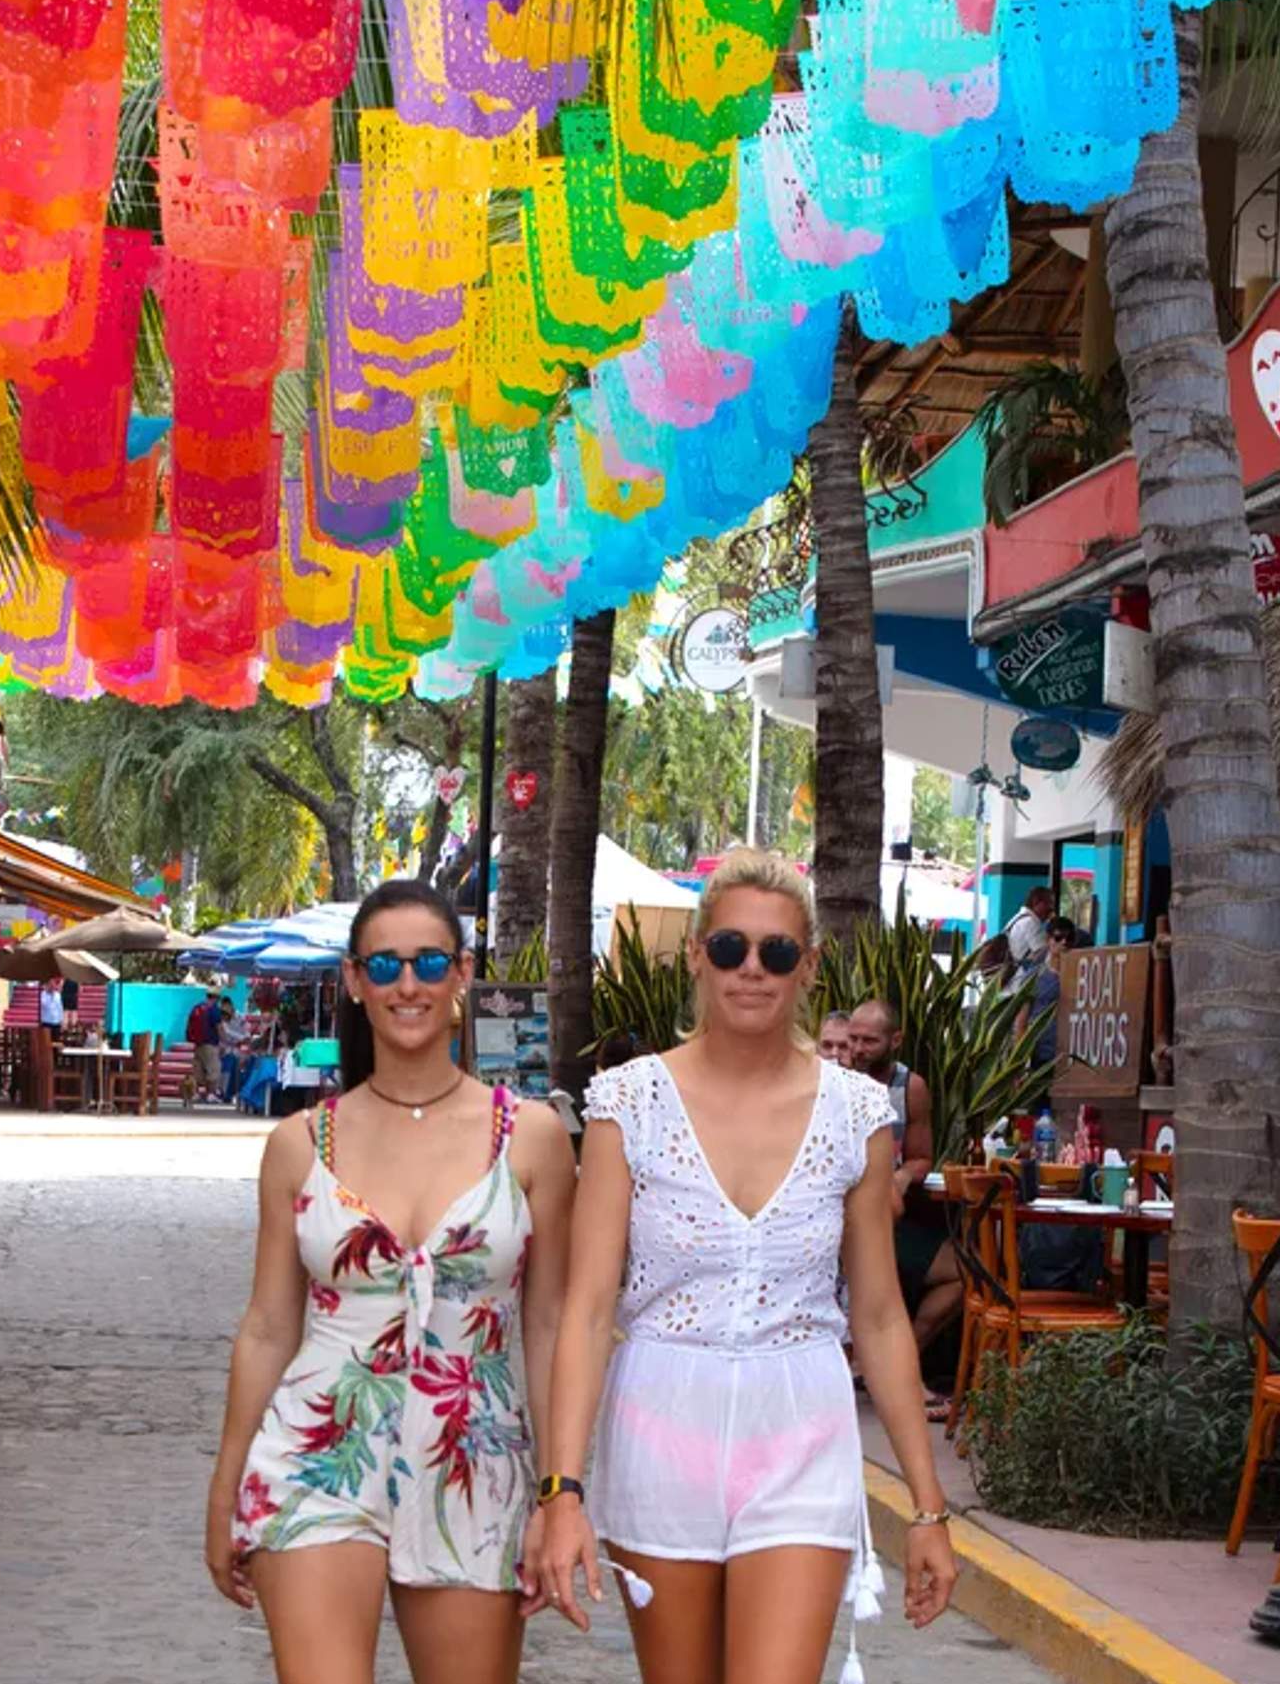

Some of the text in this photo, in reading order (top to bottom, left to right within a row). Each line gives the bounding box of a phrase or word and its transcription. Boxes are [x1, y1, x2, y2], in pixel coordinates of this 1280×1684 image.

[687, 646, 738, 665] CALYPS
[996, 619, 1067, 681] Ruben
[1075, 953, 1128, 1010] BOAT
[1067, 1012, 1129, 1067] TOURS
